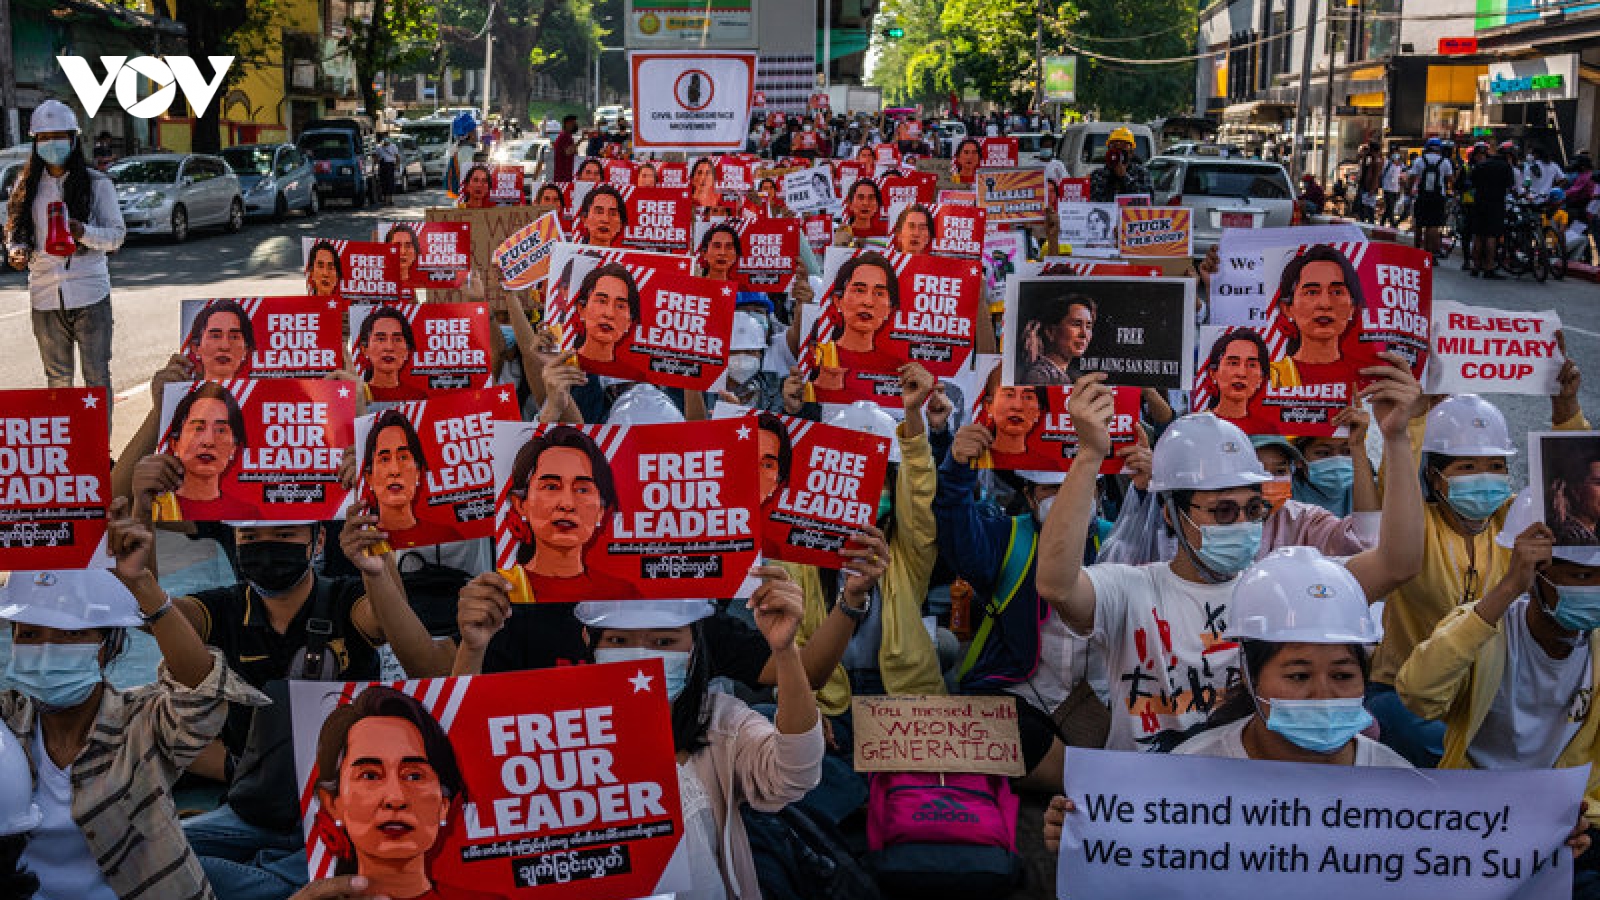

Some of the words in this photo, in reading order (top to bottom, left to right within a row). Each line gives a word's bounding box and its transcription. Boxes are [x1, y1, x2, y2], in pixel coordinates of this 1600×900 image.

[652, 112, 672, 120] CIVIL
[670, 122, 716, 130] MOVEMENT
[889, 186, 918, 196] FREE
[638, 200, 676, 214] FREE
[639, 214, 674, 226] OUR
[944, 216, 974, 230] FREE
[1128, 220, 1171, 233] FUCK
[428, 232, 458, 243] FREE
[624, 226, 686, 240] LEADER
[750, 234, 782, 244] FREE
[944, 228, 973, 242] OUR
[1128, 236, 1152, 246] THE
[428, 243, 456, 254] OUR
[500, 232, 540, 266] FUCK
[751, 245, 780, 256] OUR
[932, 240, 980, 252] LEADER
[350, 254, 384, 268] FREE
[418, 254, 467, 264] LEADER
[506, 260, 528, 279] THE
[530, 242, 553, 263] COU
[738, 256, 792, 268] LEADER
[1230, 257, 1255, 270] We
[352, 267, 384, 280] OUR
[1376, 264, 1420, 292] FREE
[340, 280, 397, 294] LEADER
[914, 274, 962, 296] FREE
[1219, 284, 1252, 296] Our
[656, 290, 712, 316] FREE
[915, 294, 958, 314] OUR
[1382, 286, 1418, 316] OUR
[268, 314, 320, 331] FREE
[425, 318, 470, 335] FREE
[656, 310, 707, 334] OUR
[894, 311, 971, 336] LEADER
[1362, 307, 1428, 338] LEADER
[1448, 314, 1544, 334] REJECT
[270, 331, 316, 350] OUR
[427, 334, 468, 350] OUR
[635, 325, 723, 355] LEADER
[1116, 328, 1144, 344] FREE
[1438, 338, 1557, 358] MILITARY
[252, 350, 336, 368] LEADER
[414, 350, 485, 366] LEADER
[1100, 358, 1124, 372] AUNG
[1126, 360, 1142, 372] SAN
[1460, 362, 1534, 380] COUP
[262, 402, 328, 424] FREE
[0, 416, 70, 445] REE
[434, 412, 494, 443] FREE
[1045, 414, 1132, 432] LEER
[265, 424, 325, 447] OUR
[242, 448, 344, 470] LEADER
[442, 437, 494, 466] OUR
[638, 450, 724, 481] FREE
[809, 446, 866, 478] FREE
[426, 460, 494, 493] LEAD
[806, 470, 860, 500] OUR
[642, 481, 721, 510] OUR
[778, 488, 872, 525] LEADER
[613, 508, 751, 538] LEADER
[871, 704, 902, 717] You
[912, 704, 973, 718] messed
[980, 704, 1018, 718] with
[488, 706, 616, 756] FREE
[880, 721, 988, 740] WRONG
[862, 740, 1018, 762] GENERATION
[501, 748, 619, 795] OUR
[462, 782, 667, 840] LEADER
[912, 810, 979, 823] adidas
[1084, 794, 1134, 824] We
[1144, 794, 1232, 826] stand
[1240, 796, 1311, 828] with
[1322, 800, 1510, 838] democracy!
[1083, 840, 1132, 867] We
[1142, 840, 1230, 871] stand
[1240, 844, 1311, 872] with
[1318, 845, 1402, 881] Aung
[1414, 847, 1470, 877] San
[1482, 849, 1521, 879] Su
